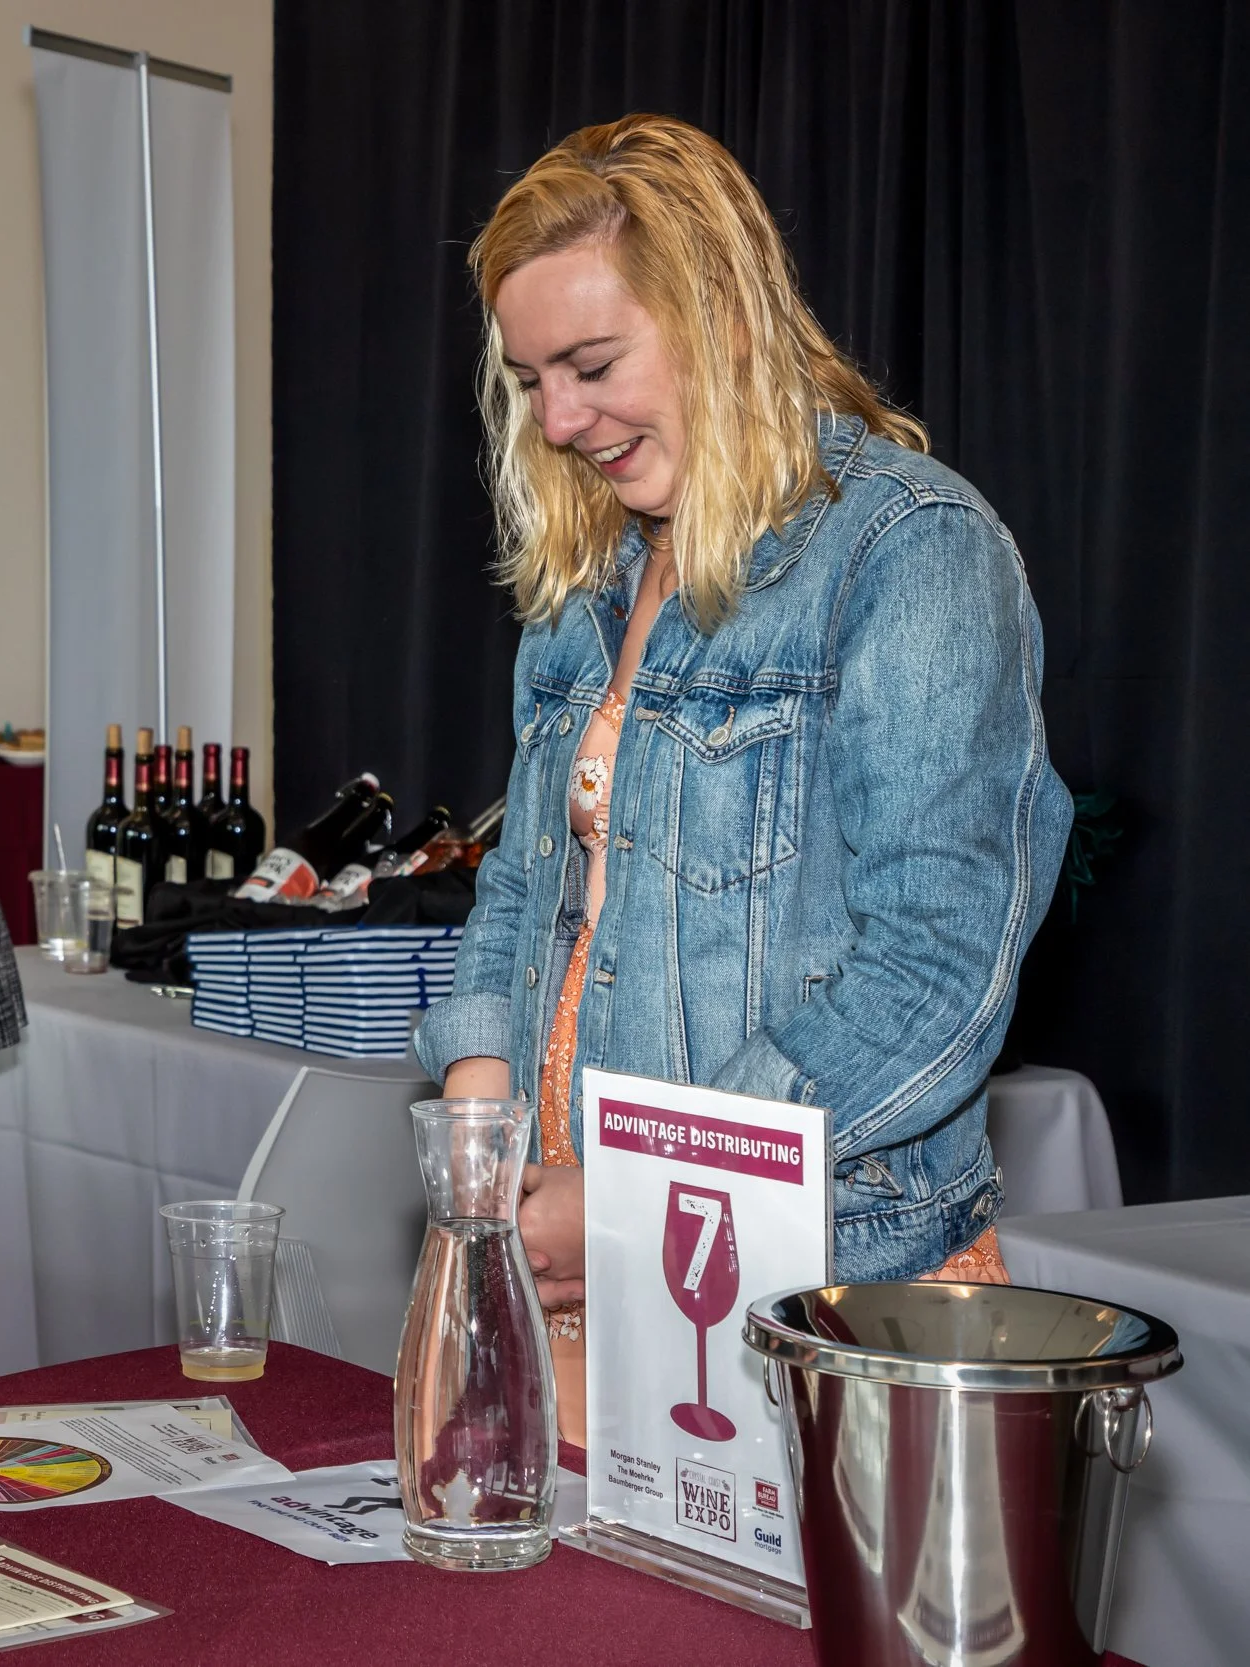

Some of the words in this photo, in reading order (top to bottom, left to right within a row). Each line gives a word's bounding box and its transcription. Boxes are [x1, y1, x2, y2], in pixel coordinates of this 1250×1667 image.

[604, 1112, 686, 1144] ADVINTAGE
[690, 1126, 801, 1166] DISTRIBUTING
[678, 1192, 723, 1292] 7
[610, 1449, 635, 1464] Morgan
[636, 1456, 661, 1473] Stanley
[617, 1464, 628, 1475] The
[608, 1474, 644, 1492] Baumberger
[644, 1486, 664, 1499] Group
[681, 1480, 730, 1514] WINE
[271, 1496, 380, 1540] advintage
[684, 1501, 731, 1531] EXPO
[754, 1527, 782, 1548] Guild
[754, 1540, 782, 1555] mortgage
